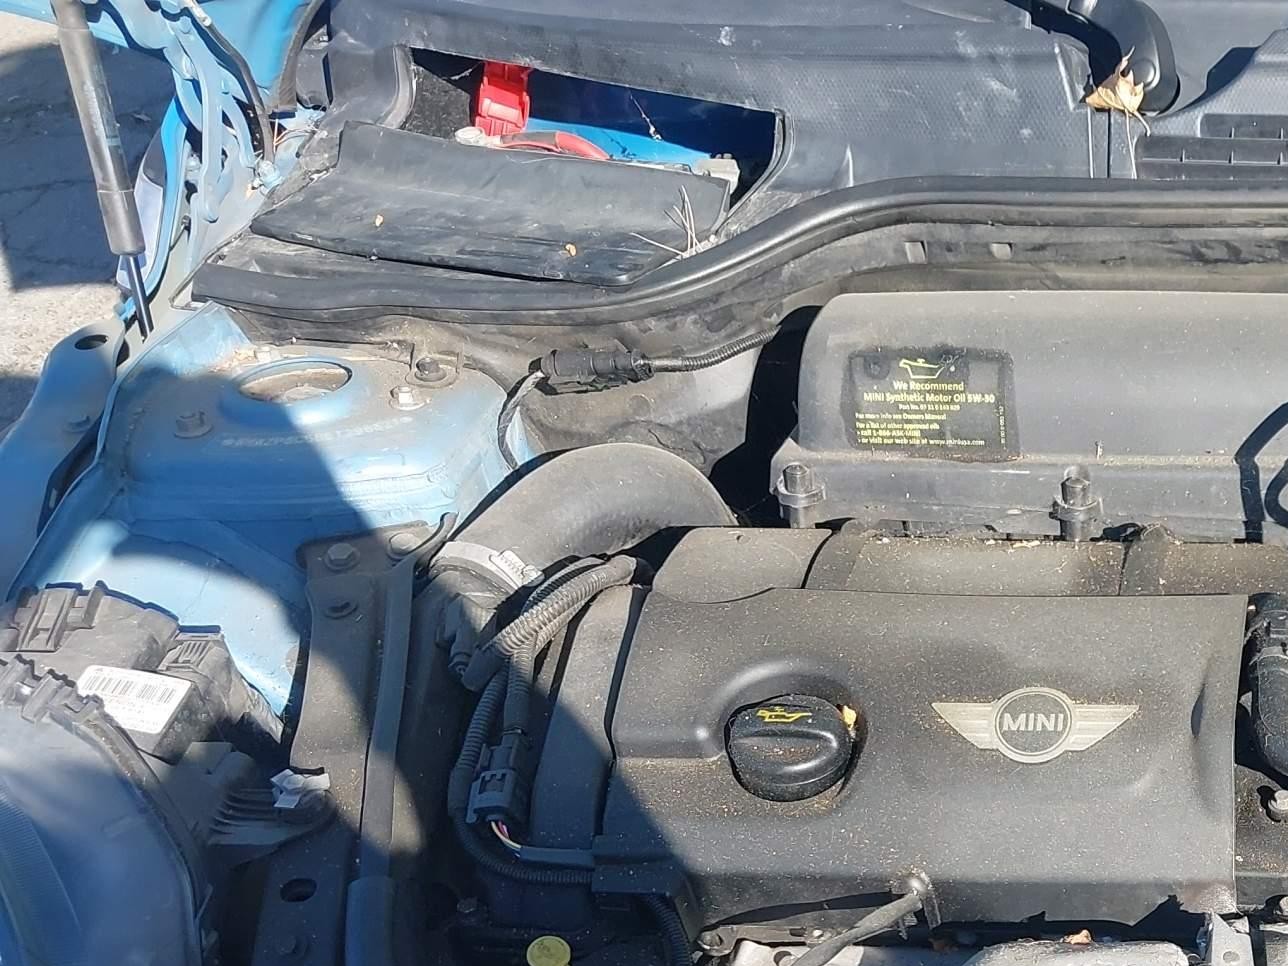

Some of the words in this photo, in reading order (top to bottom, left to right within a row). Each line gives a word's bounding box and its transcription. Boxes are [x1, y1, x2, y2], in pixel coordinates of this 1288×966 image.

[893, 380, 908, 390] We
[910, 380, 964, 391] Recommend
[864, 392, 884, 402] MINI
[886, 392, 924, 404] Synthetic
[926, 393, 951, 402] Motor
[953, 393, 965, 403] Oil
[967, 393, 995, 403] 5W-30
[1002, 712, 1064, 732] MINI
